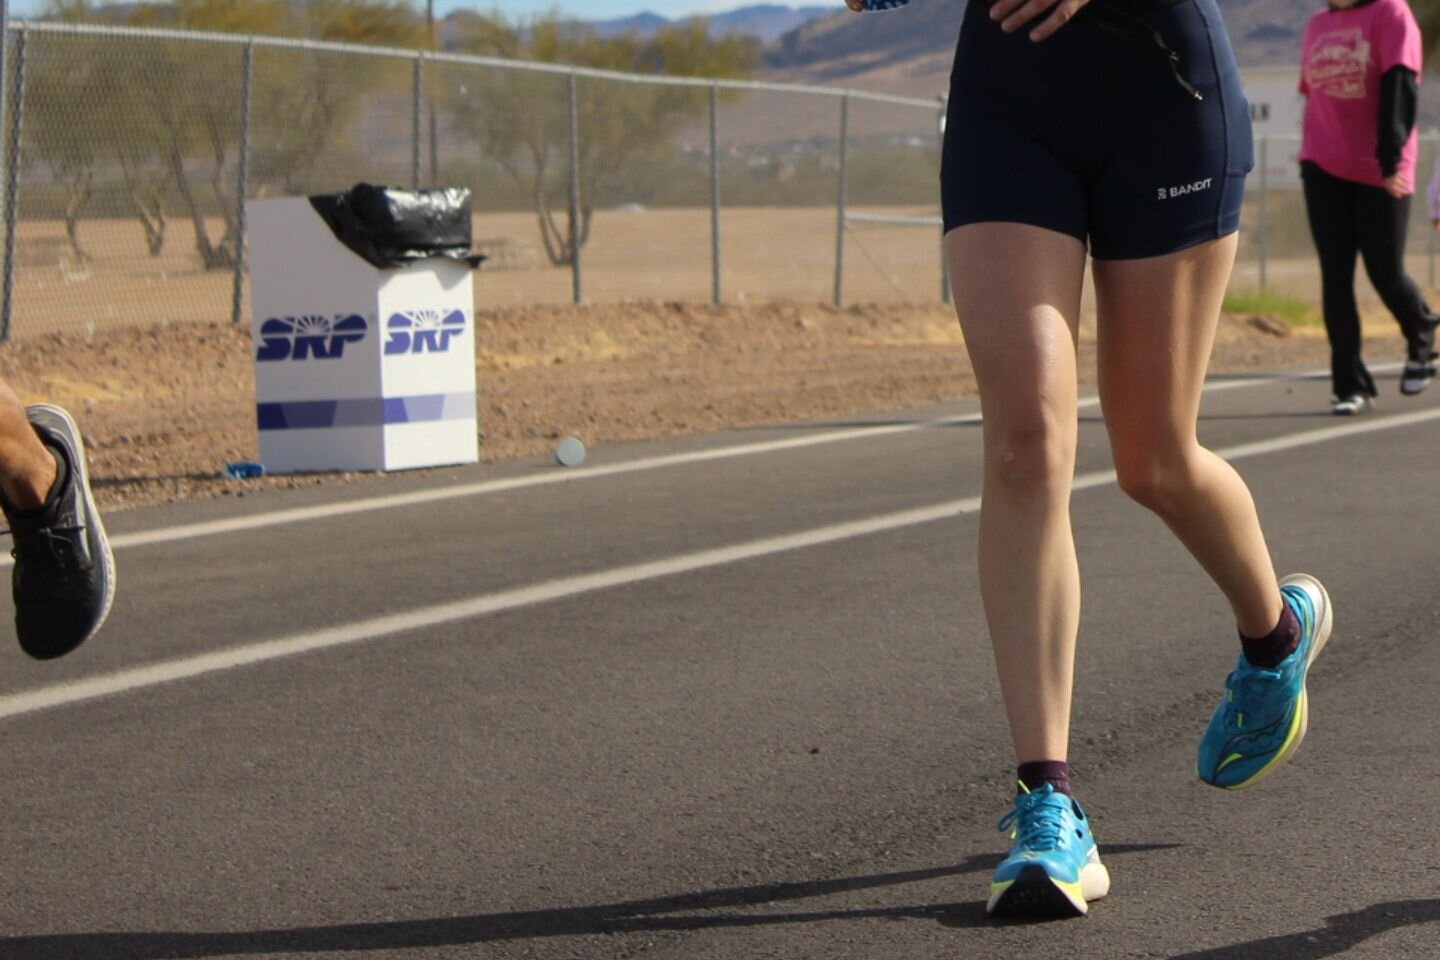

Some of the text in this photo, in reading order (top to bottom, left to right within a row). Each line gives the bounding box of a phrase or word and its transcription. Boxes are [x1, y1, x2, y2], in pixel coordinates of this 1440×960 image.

[1169, 178, 1212, 197] BANDIT
[256, 314, 368, 362] SRP
[384, 309, 467, 356] SRP
